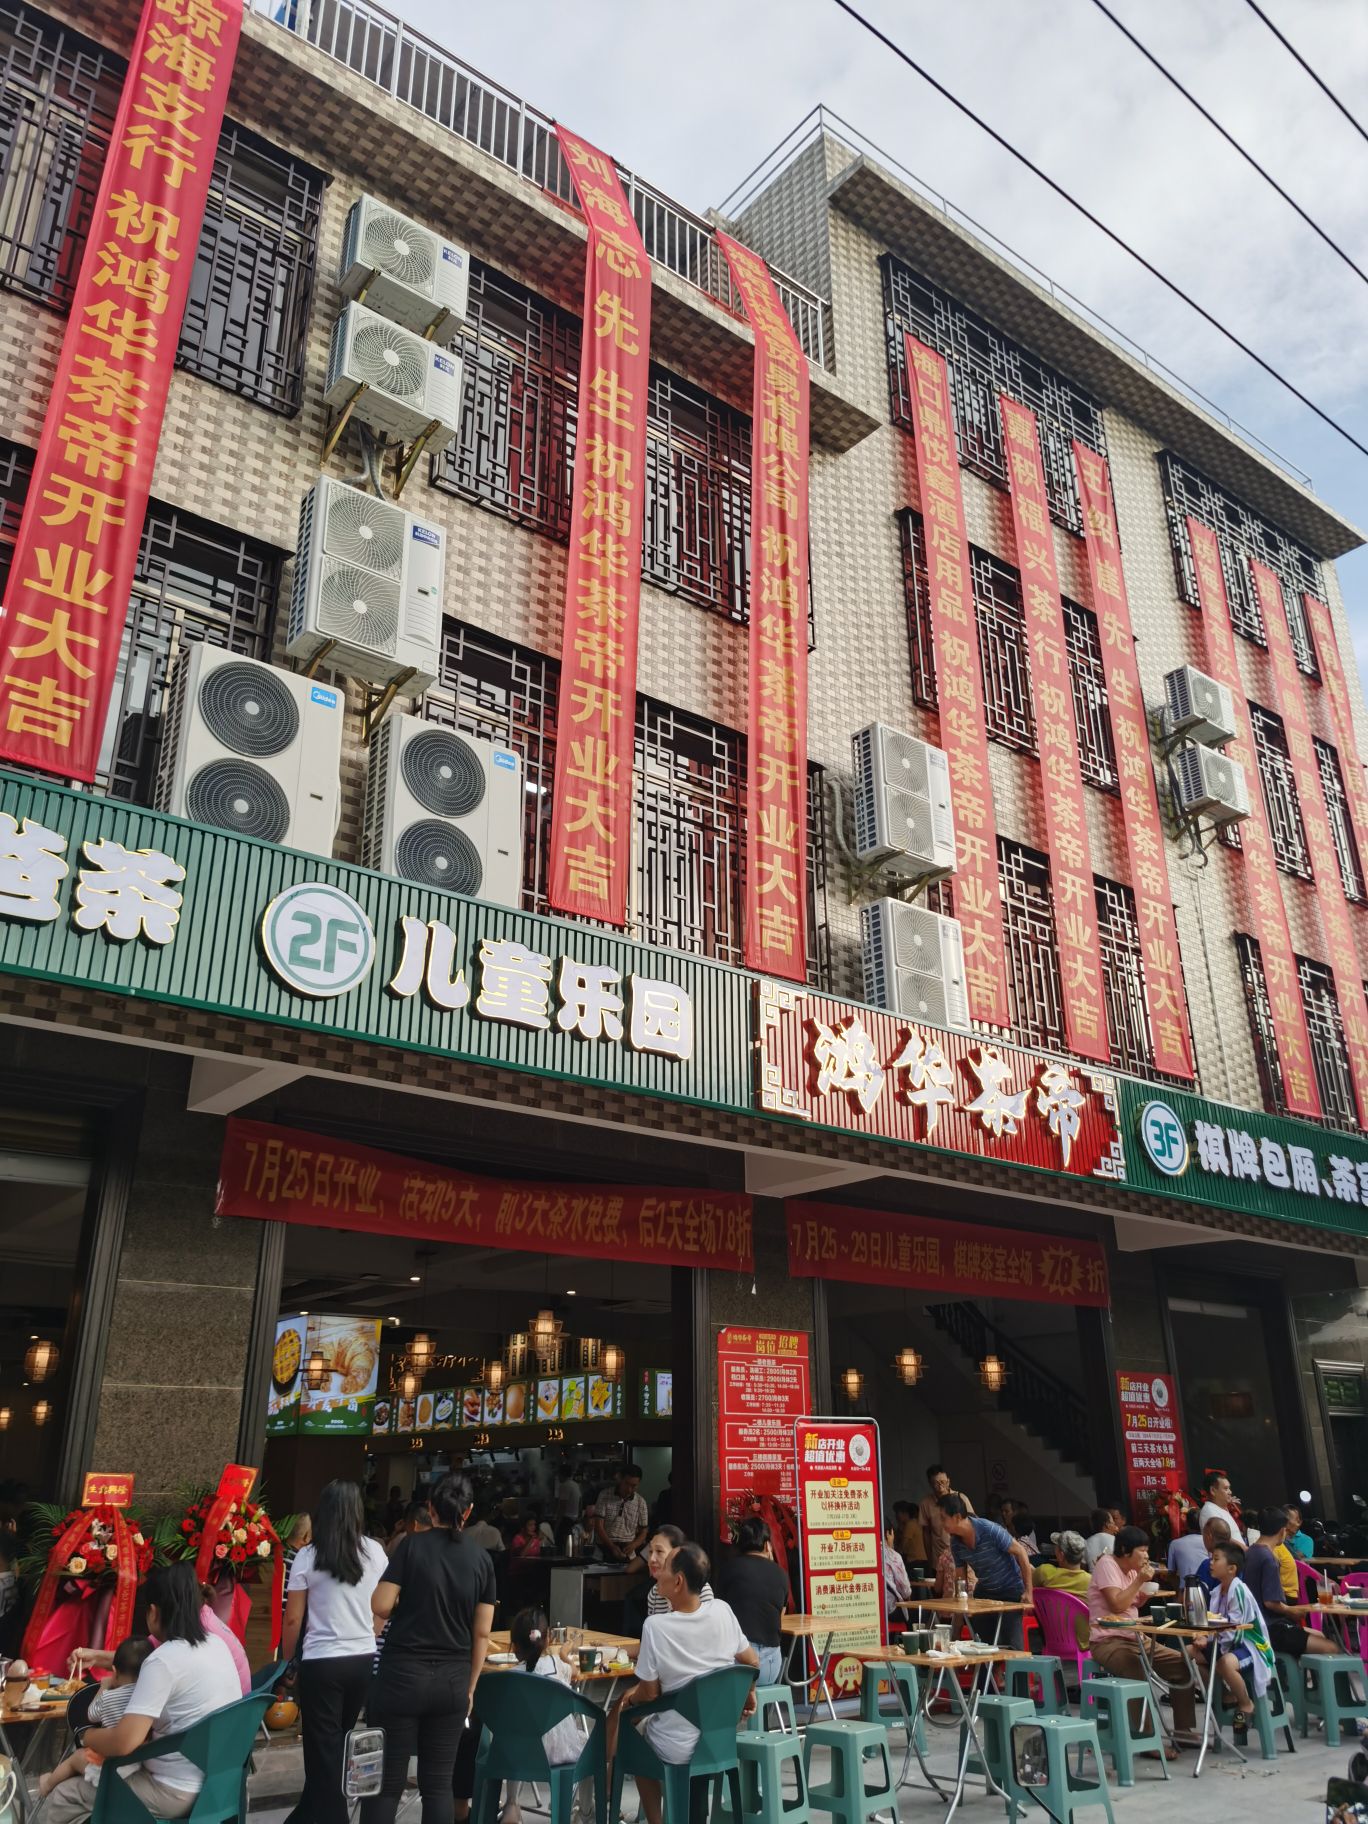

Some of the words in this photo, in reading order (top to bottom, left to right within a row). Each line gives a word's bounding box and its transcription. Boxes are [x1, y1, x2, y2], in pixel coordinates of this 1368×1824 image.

[564, 141, 641, 900] 刘海志先生祝鸿华茶帝开业大吉
[1006, 409, 1099, 1040] 嘉积福兴茶行祝鸿华茶帝开业大吉
[288, 910, 361, 973] 2F
[390, 915, 692, 1060] 儿童乐园
[1150, 1119, 1180, 1159] 3F
[804, 1432, 846, 1450] 新店开业
[804, 1450, 846, 1463] 超值优惠
[820, 1541, 866, 1553] 开业7.8折活动
